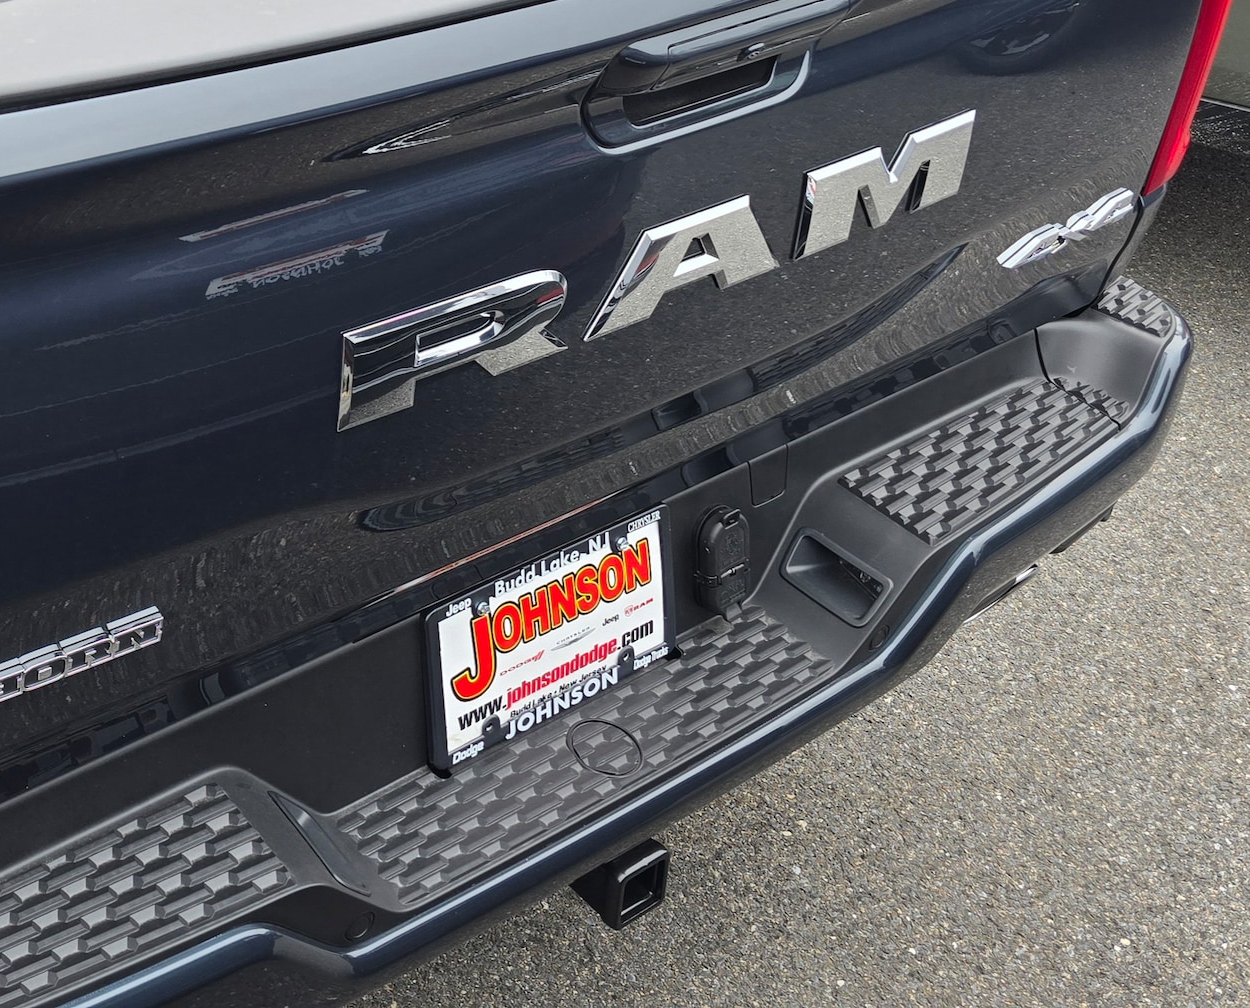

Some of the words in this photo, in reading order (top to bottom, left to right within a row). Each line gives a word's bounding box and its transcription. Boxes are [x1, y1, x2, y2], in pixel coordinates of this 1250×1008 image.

[337, 108, 976, 433] RAM
[627, 511, 661, 533] CHRYSLER
[494, 563, 536, 597] Budd
[588, 532, 610, 554] NJ
[446, 598, 472, 617] Jeep
[634, 598, 654, 611] RAM
[450, 537, 653, 701] JOHNSON
[602, 614, 620, 627] Jeep
[556, 626, 591, 645] CHRYSLER
[457, 619, 654, 731] www.johnsondodge.com
[505, 667, 618, 740] JOHNSON
[452, 741, 485, 765] Dodge
